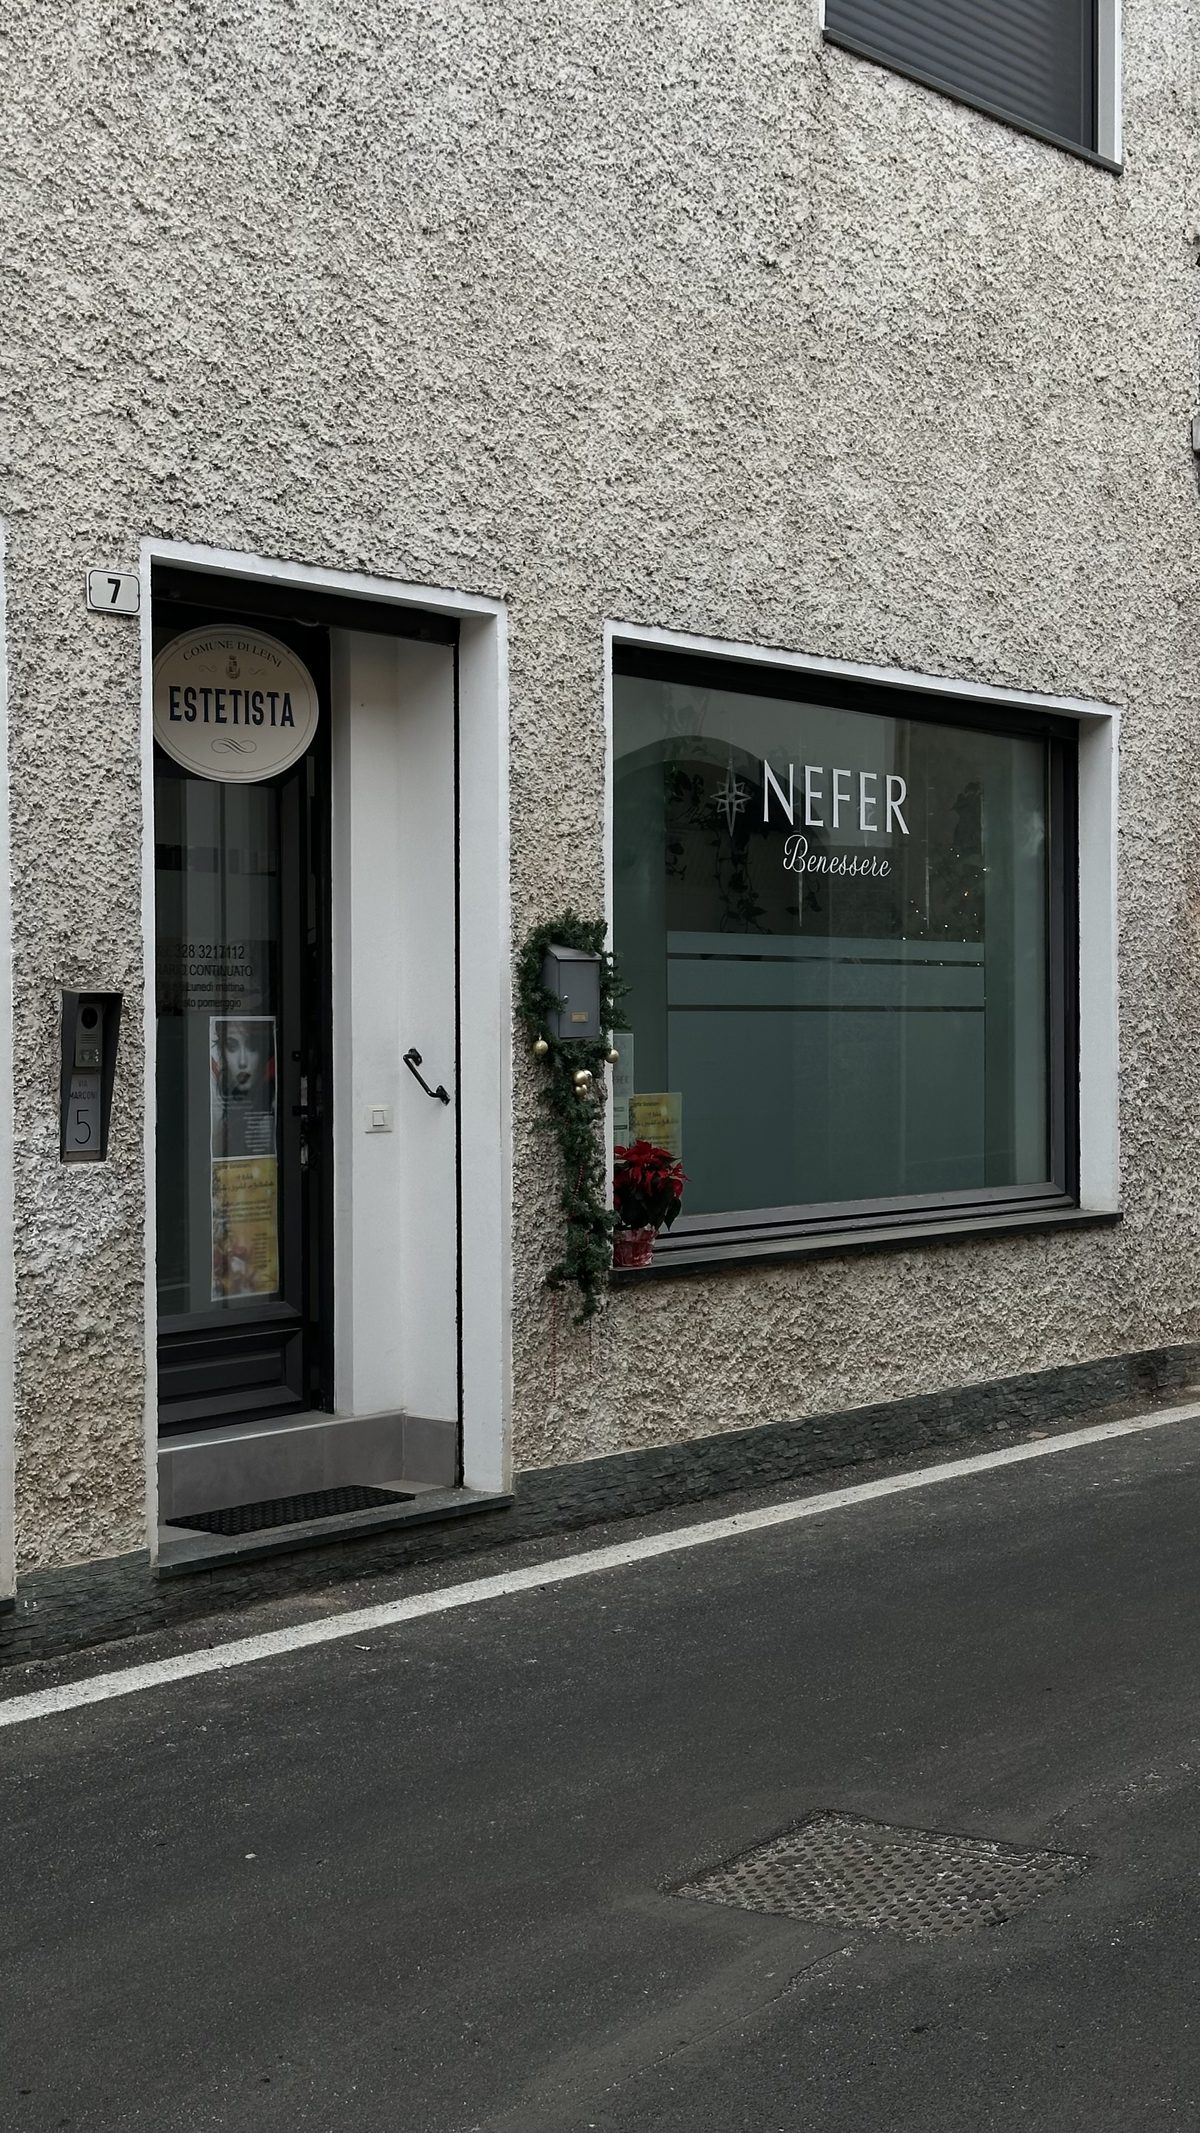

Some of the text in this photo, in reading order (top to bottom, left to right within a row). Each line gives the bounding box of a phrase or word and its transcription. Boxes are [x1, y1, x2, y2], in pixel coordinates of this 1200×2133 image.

[107, 577, 121, 604] 7
[183, 640, 234, 661] COMUNE
[237, 641, 250, 652] DI
[168, 685, 295, 728] ESTETISTA
[763, 759, 910, 835] NEFER
[782, 833, 892, 877] Benessere
[189, 963, 254, 977] CONTINUATO
[74, 1109, 92, 1145] 5
